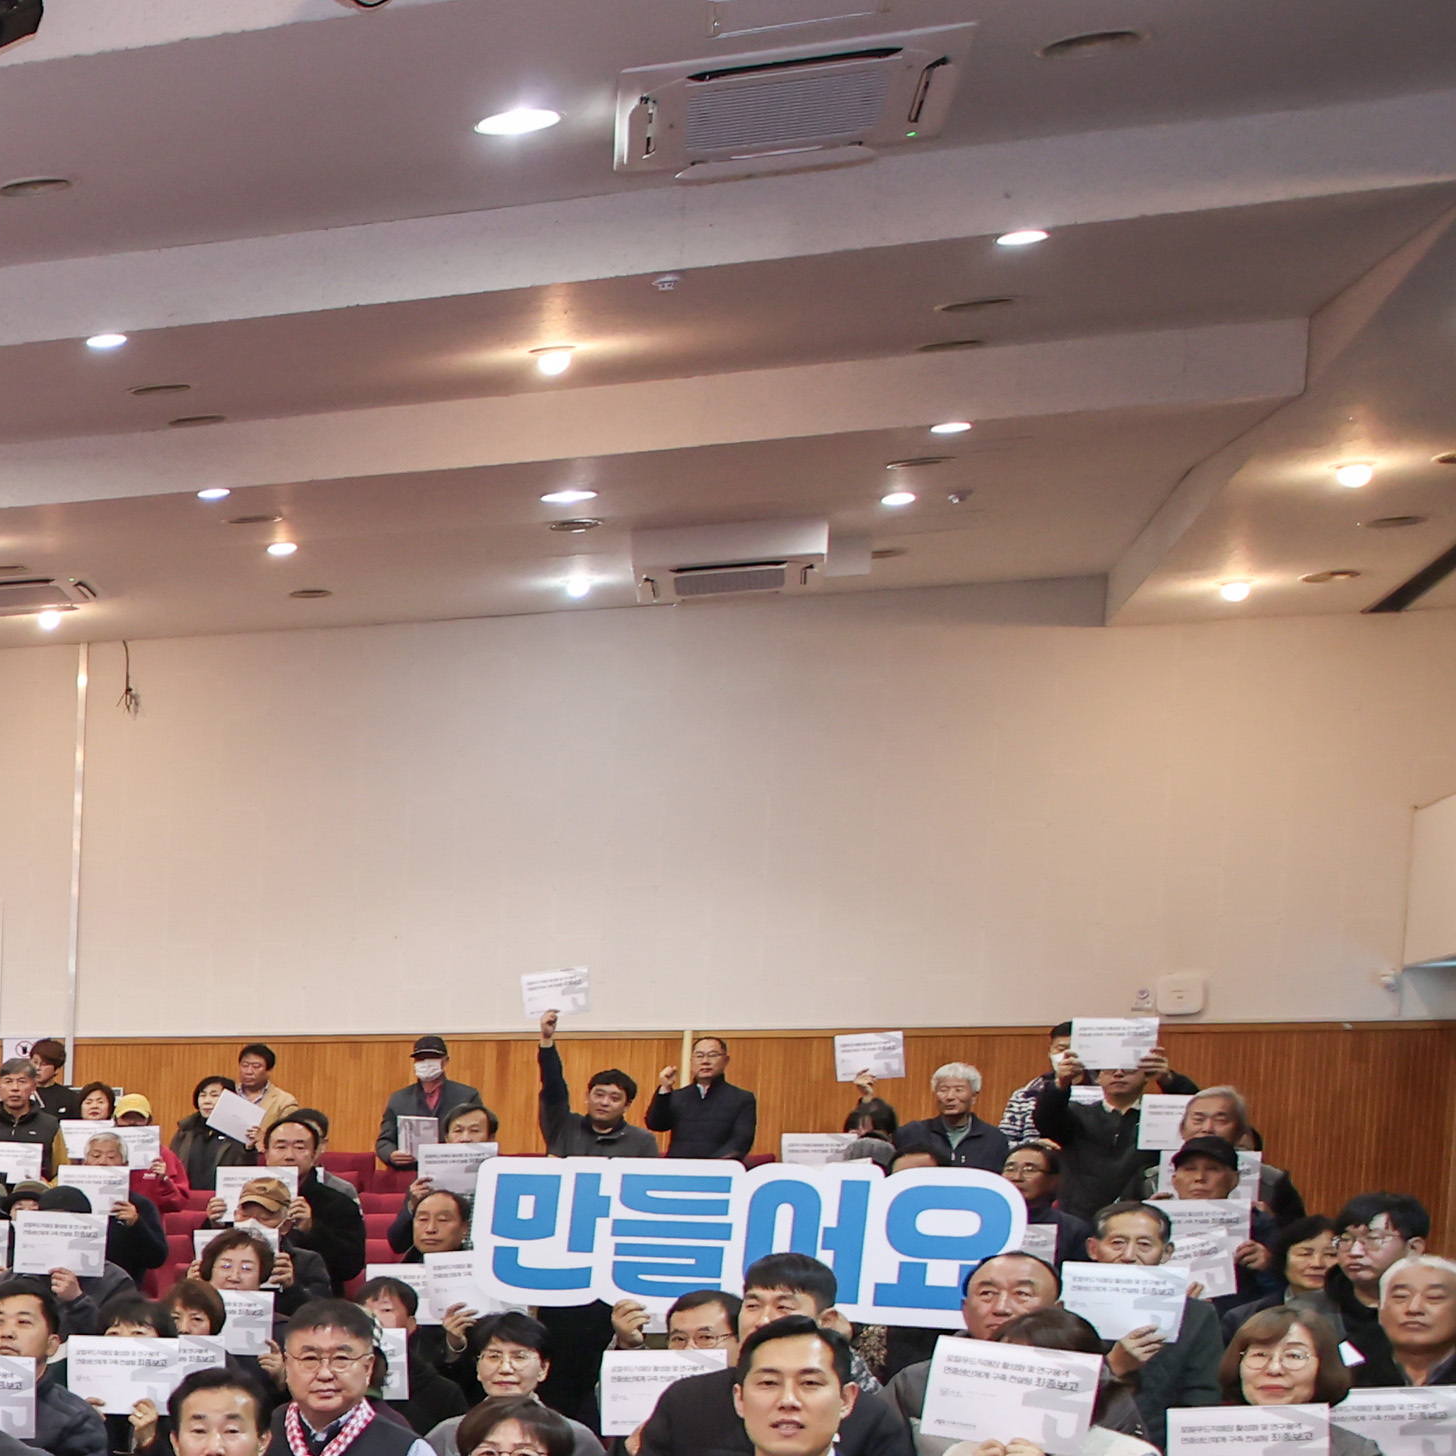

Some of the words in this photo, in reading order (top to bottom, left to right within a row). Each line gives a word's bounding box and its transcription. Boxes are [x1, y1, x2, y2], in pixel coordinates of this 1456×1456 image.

[492, 1172, 1012, 1311] 만들어요
[1035, 1376, 1079, 1392] 최종보고
[1270, 1432, 1314, 1442] 최종보고
